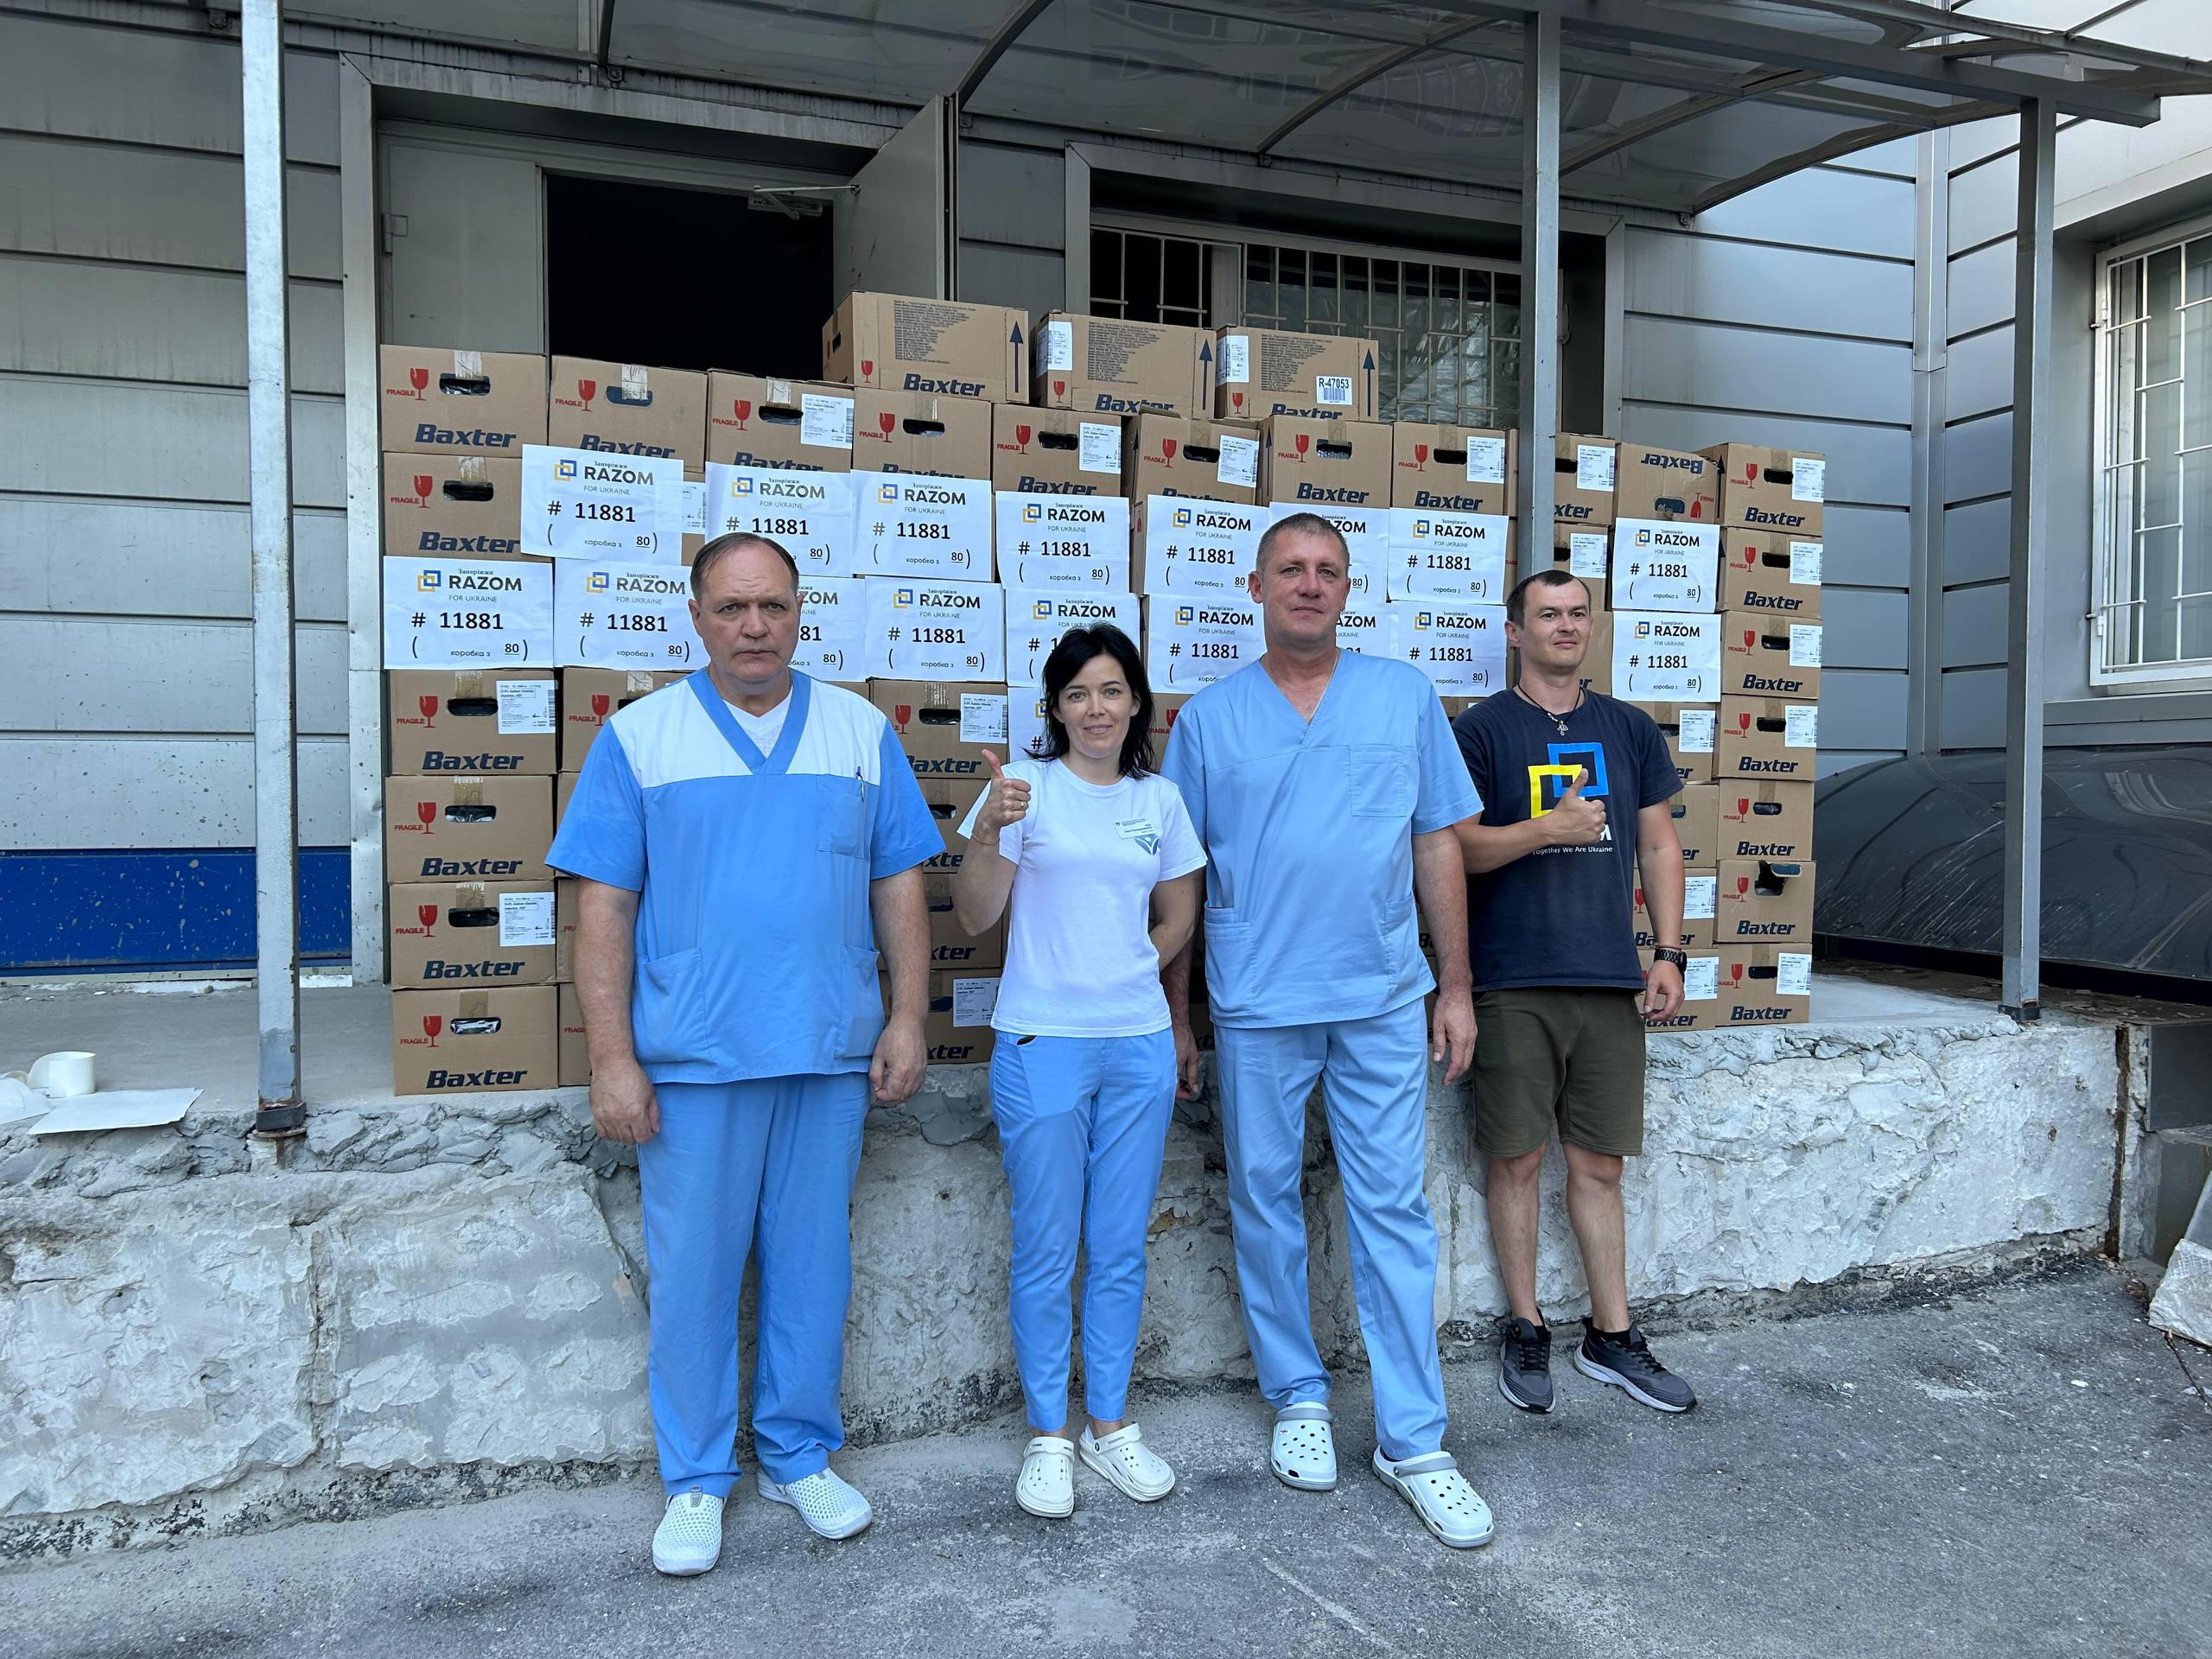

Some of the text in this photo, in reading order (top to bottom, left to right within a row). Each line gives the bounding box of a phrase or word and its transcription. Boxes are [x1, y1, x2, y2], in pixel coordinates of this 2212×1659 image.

[903, 373, 985, 397] Baxter
[1319, 378, 1350, 389] R-47053
[555, 398, 582, 407] FRAGILE
[712, 417, 739, 427] FRAGILE
[415, 423, 517, 448] Baxter
[1641, 453, 1704, 474] Baxter
[584, 466, 654, 486] RAZOM
[600, 486, 630, 495] UKRAINE
[760, 482, 825, 499] RAZOM
[904, 488, 966, 505] RAZOM
[1296, 483, 1369, 504] Baxter
[773, 501, 804, 510] UKRAINE
[1414, 491, 1483, 511] Baxter
[548, 500, 636, 523] # 11881
[918, 507, 946, 516] UKRAINE
[1047, 506, 1105, 523] RAZOM
[1554, 504, 1593, 518] xter
[1745, 506, 1805, 527] Baxter
[726, 517, 809, 536] # 11881
[1196, 514, 1251, 531] RAZOM
[1334, 520, 1366, 533] ZOM
[873, 522, 950, 540] # 11881
[1434, 524, 1485, 539] RAZOM
[418, 531, 520, 554] Baxter
[636, 536, 650, 547] 80
[1655, 533, 1700, 547] RAZOM
[810, 548, 823, 559] 80
[1019, 541, 1091, 557] # 11881
[1166, 545, 1236, 565] # 11881
[950, 551, 963, 563] 80
[1408, 554, 1471, 571] # 11881
[1091, 569, 1103, 579] 80
[1630, 563, 1688, 578] # 11881
[448, 575, 522, 592] RAZOM
[616, 578, 686, 594] RAZOM
[1235, 577, 1246, 587] 80
[1352, 578, 1363, 588] 80
[1471, 582, 1481, 592] 80
[798, 591, 838, 605] ZOM
[1687, 588, 1696, 597] 80
[919, 594, 981, 609] RAZOM
[1744, 590, 1803, 611] Baxter
[1058, 605, 1116, 619] RAZOM
[1199, 611, 1254, 626] RAZOM
[411, 612, 504, 630] # 11881
[580, 612, 668, 632] # 11881
[1337, 616, 1376, 627] AZOM
[1436, 616, 1486, 630] RAZOM
[888, 627, 965, 644] # 11881
[1655, 625, 1700, 638] RAZOM
[505, 643, 519, 654] 80
[668, 645, 683, 657] 80
[1028, 638, 1039, 652] #
[1169, 643, 1239, 659] # 11881
[823, 654, 836, 664] 80
[966, 656, 978, 666] 80
[1409, 647, 1472, 662] # 11881
[1629, 655, 1688, 669] # 11881
[1472, 673, 1483, 683] 80
[1687, 678, 1696, 688] 80
[1742, 674, 1802, 693] Baxter
[422, 751, 524, 770] Baxter
[1738, 756, 1798, 773] Baxter
[1736, 841, 1795, 856] Baxter
[420, 858, 523, 876] Baxter
[925, 853, 963, 867] xte
[1737, 920, 1796, 935] Baxter
[1636, 932, 1695, 946] Baer
[423, 960, 525, 979] Baxter
[1731, 1006, 1791, 1020] Baxter
[927, 1045, 974, 1059] xter
[426, 1070, 527, 1089] Baxter
